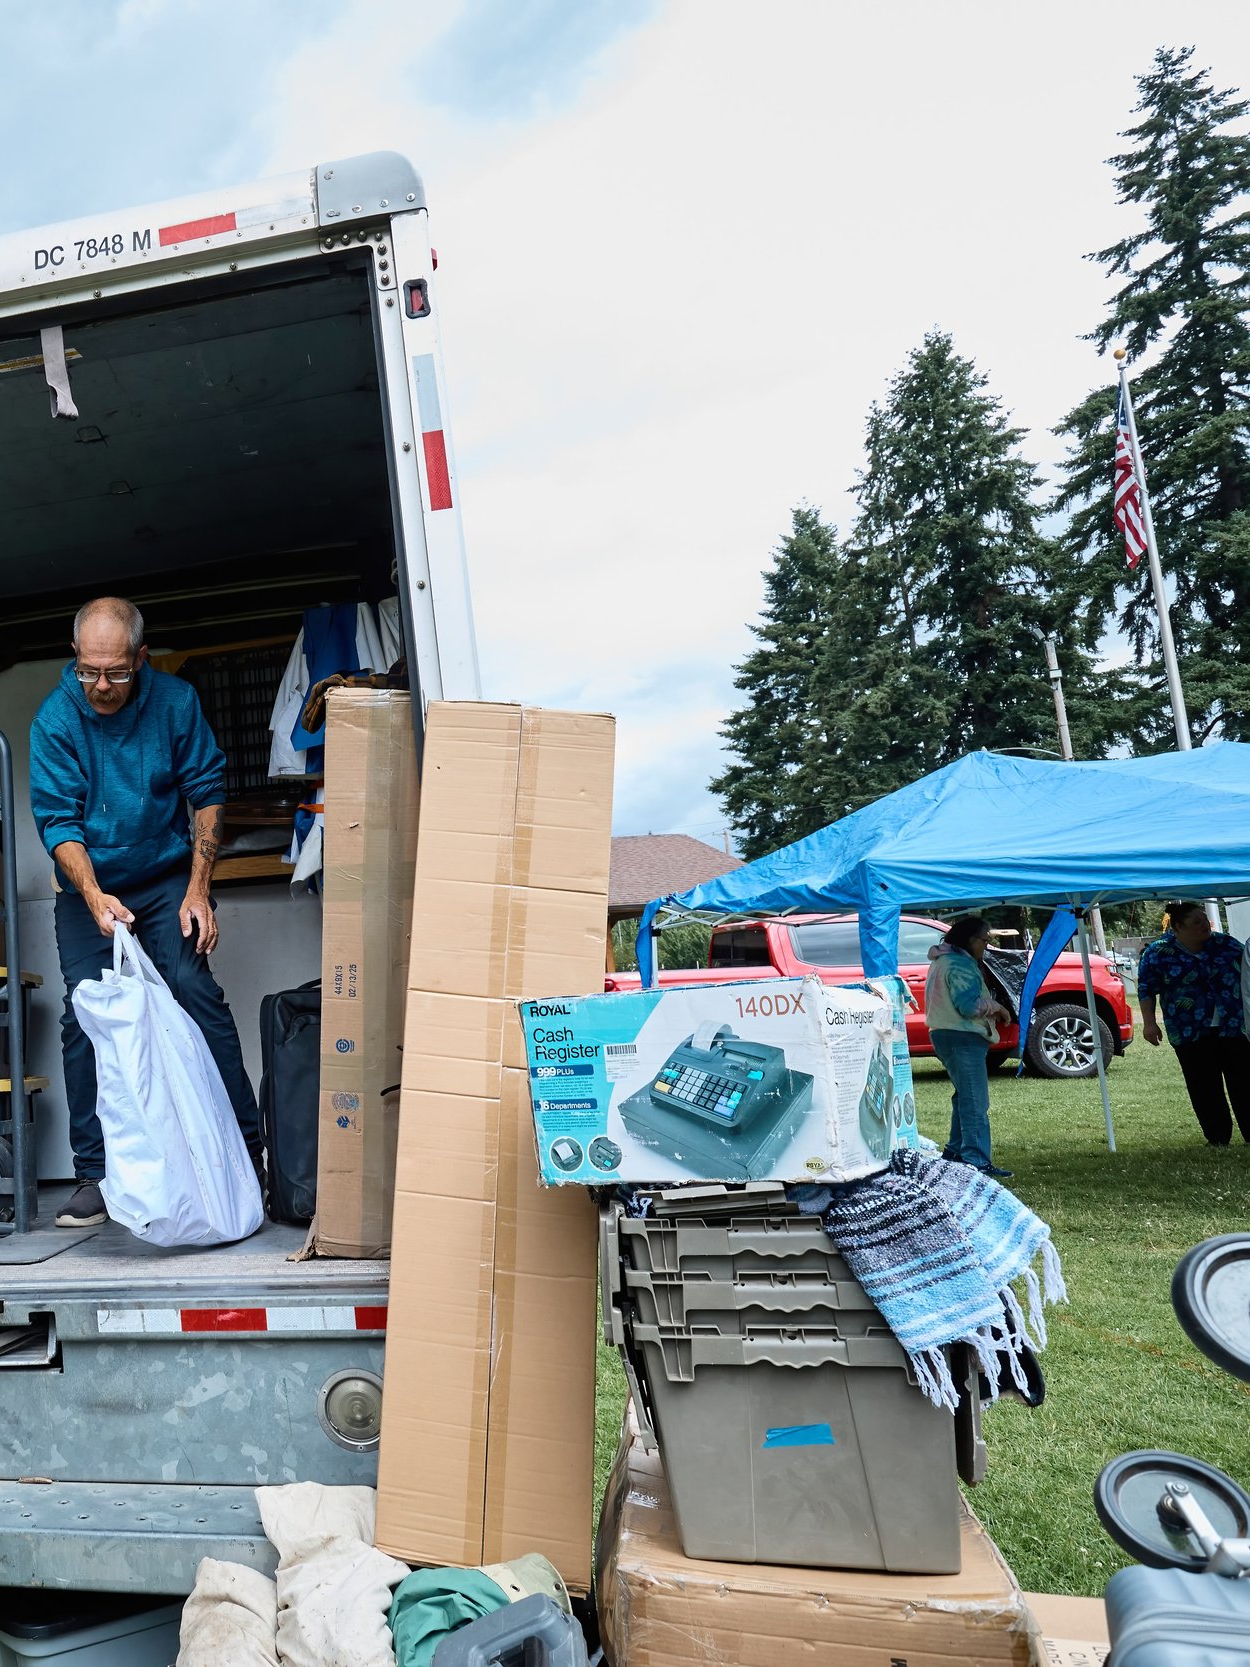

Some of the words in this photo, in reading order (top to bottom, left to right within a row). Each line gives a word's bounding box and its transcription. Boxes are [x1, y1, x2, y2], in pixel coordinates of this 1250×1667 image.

[34, 245, 65, 270] DC
[73, 234, 124, 261] 7848
[132, 229, 151, 252] M
[348, 963, 357, 998] 02/13/25
[530, 1005, 570, 1017] ROYAL
[735, 992, 806, 1018] 140DX
[825, 1007, 849, 1025] Cash
[533, 1026, 574, 1043] Cash
[535, 1044, 600, 1063] Register
[536, 1066, 557, 1077] 999
[556, 1068, 575, 1076] PLUs
[539, 1100, 550, 1111] 16
[550, 1102, 591, 1111] Departments
